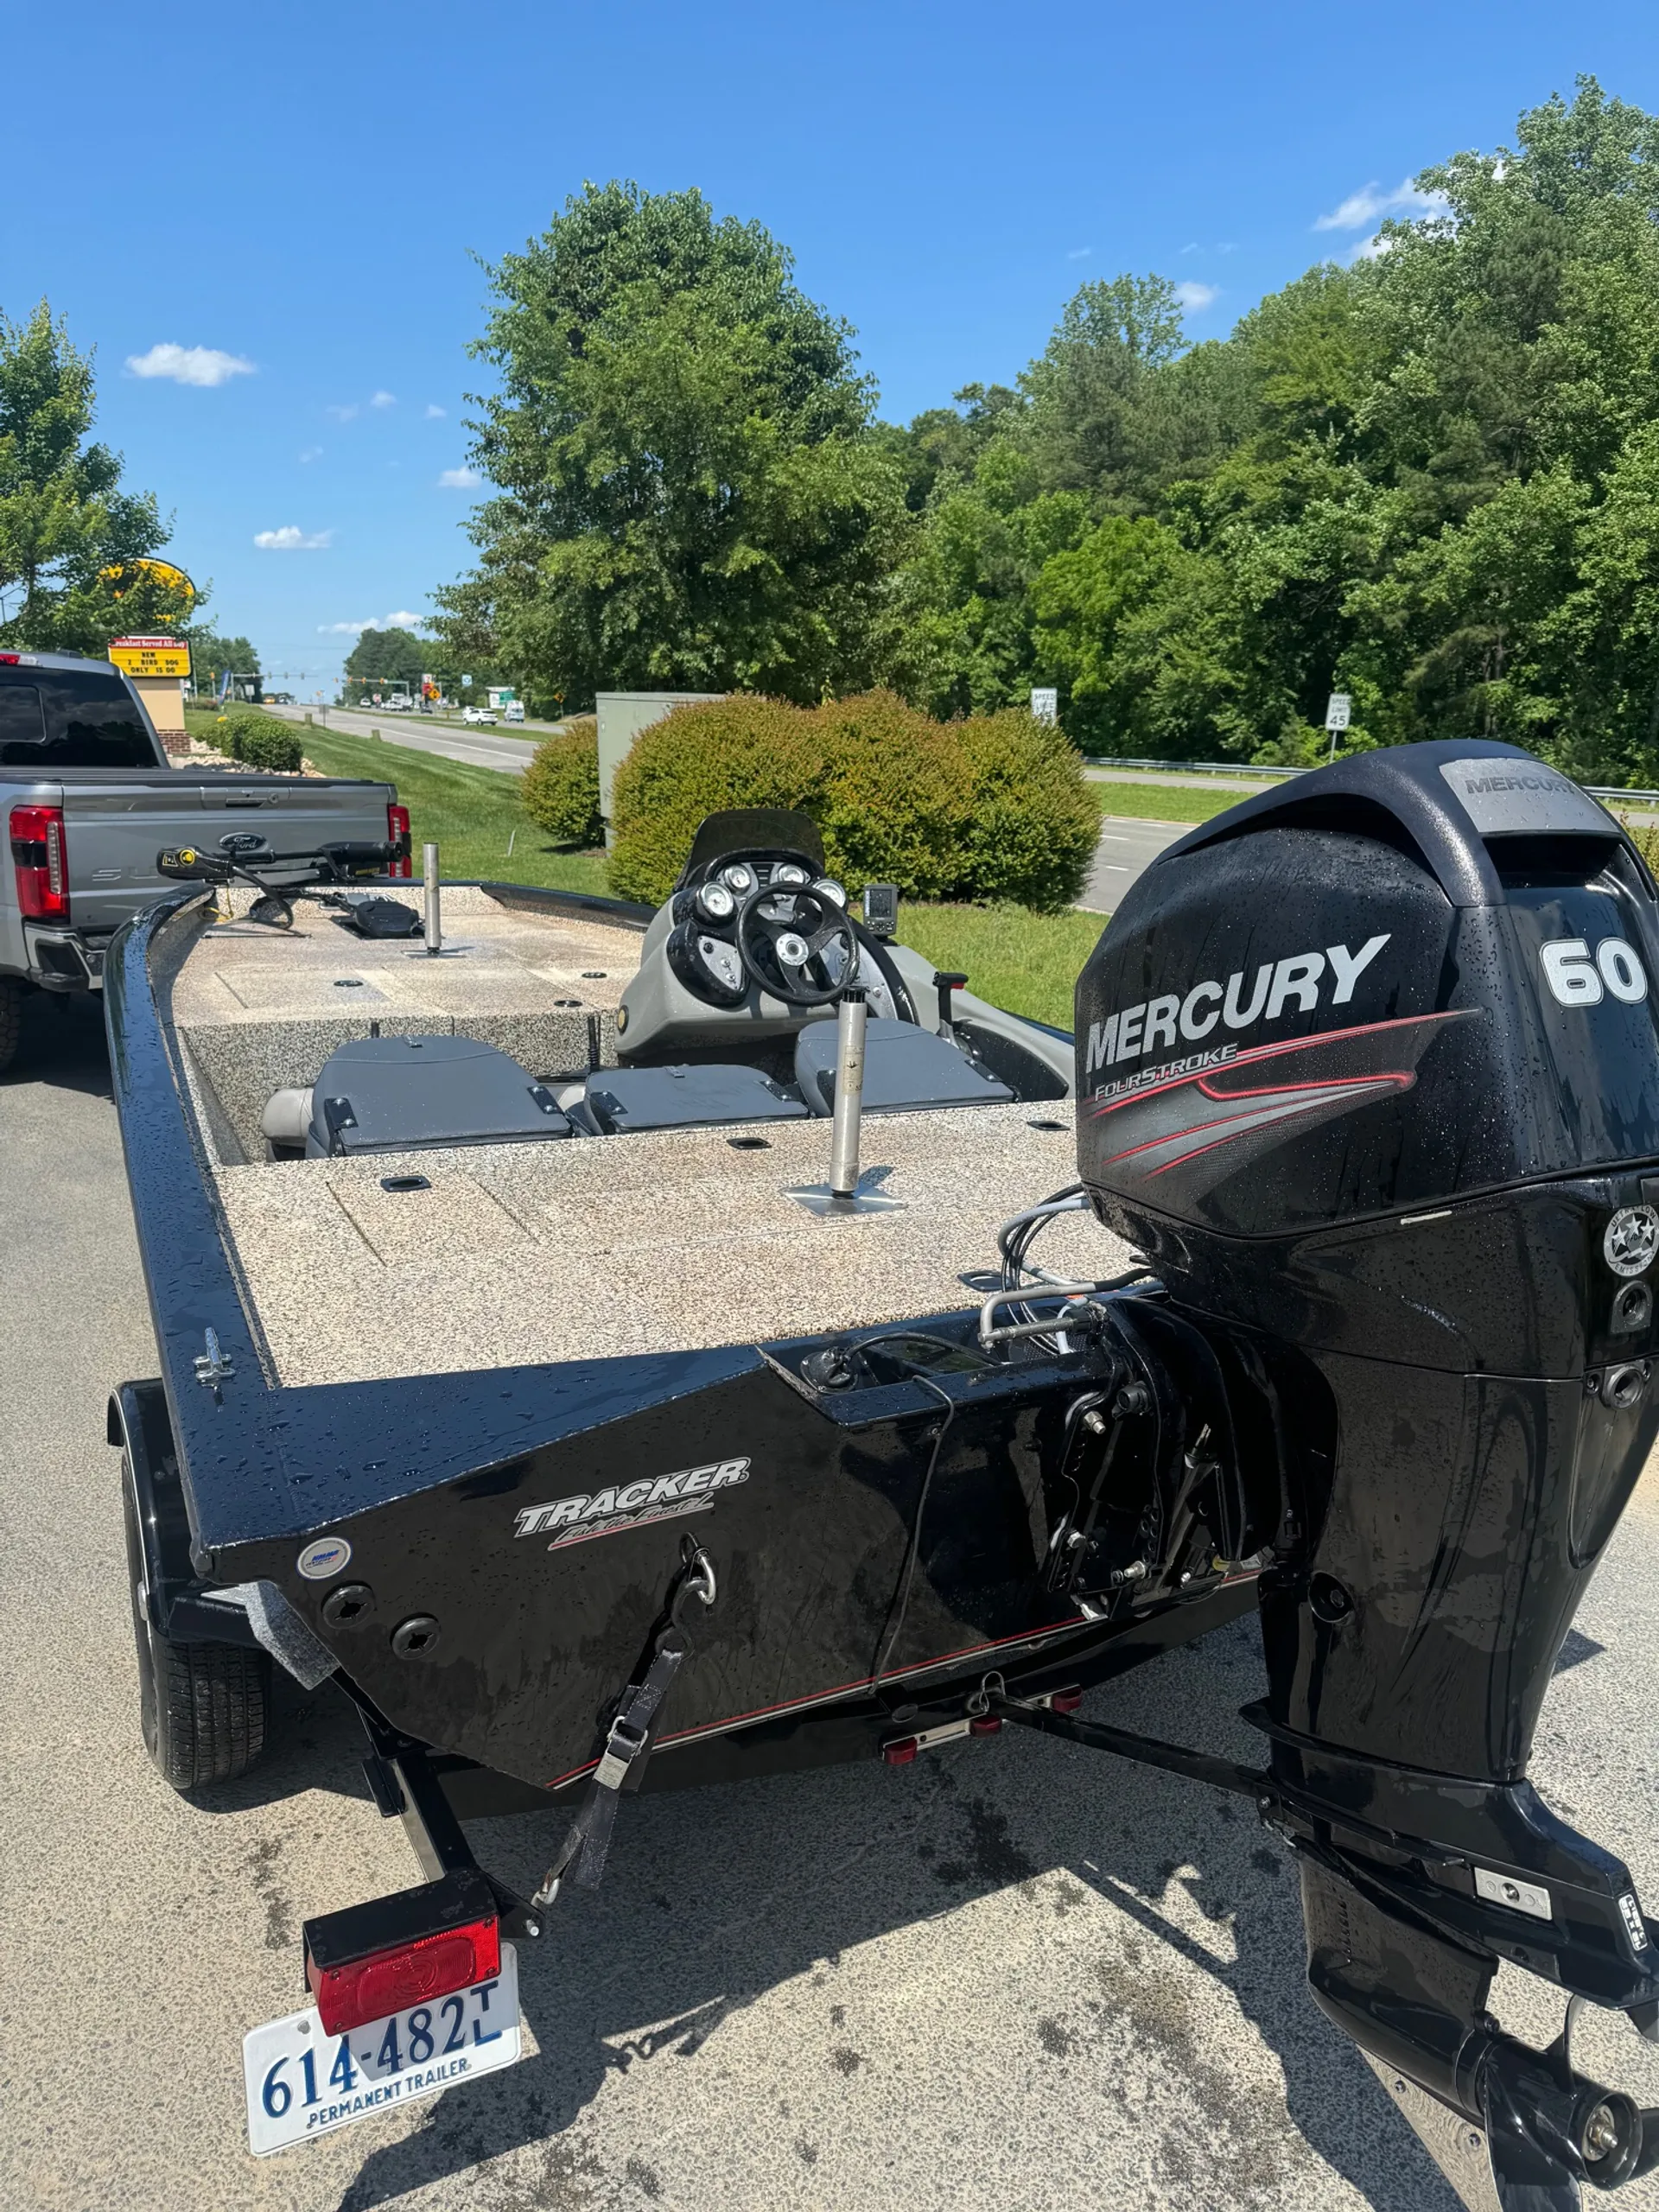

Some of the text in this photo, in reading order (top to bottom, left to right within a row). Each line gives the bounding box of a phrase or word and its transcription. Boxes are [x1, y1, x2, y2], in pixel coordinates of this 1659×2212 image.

[1330, 715, 1345, 726] 45
[1465, 776, 1575, 795] MERCURY
[233, 836, 257, 849] Ford
[1085, 933, 1392, 1073] MERCURY
[1539, 937, 1648, 1007] 60
[1095, 1043, 1238, 1102] FOURSTROKE
[516, 1458, 749, 1535] TRACKER
[308, 2057, 468, 2125] PERMANENT TRAILER
